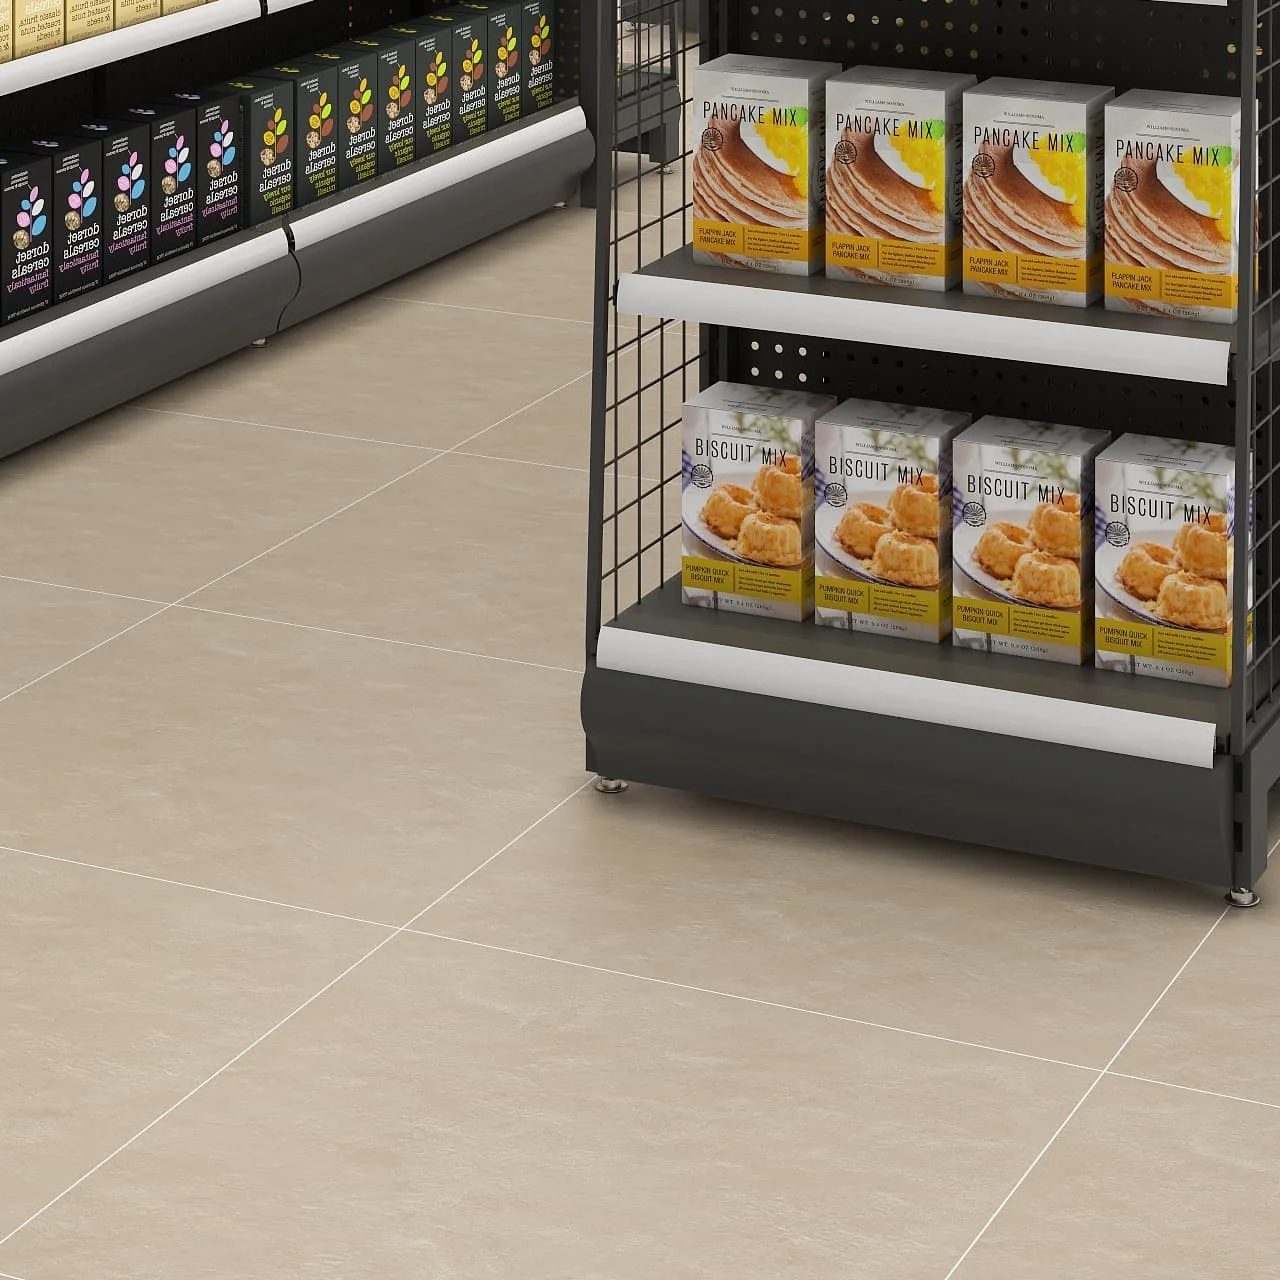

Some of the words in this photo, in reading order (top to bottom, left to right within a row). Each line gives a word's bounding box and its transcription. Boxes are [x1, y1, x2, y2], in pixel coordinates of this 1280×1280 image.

[703, 101, 765, 124] PANCAKE
[773, 108, 796, 126] MIX
[837, 113, 900, 137] PANCAKE
[908, 120, 933, 139] MIX
[974, 126, 1039, 150] PANCAKE
[1048, 134, 1074, 153] MIX
[1116, 139, 1183, 164] PANCAKE
[1193, 147, 1219, 167] MIX
[1112, 272, 1136, 282] FLAPPIN
[1137, 274, 1152, 283] JACK
[1112, 281, 1139, 290] PANCAKE
[1140, 283, 1152, 292] MIX
[696, 438, 753, 463] BISCUIT
[762, 447, 787, 468] MIX
[829, 456, 889, 481] BISCUIT
[898, 465, 923, 486] MIX
[967, 475, 1028, 500] BISCUIT
[1038, 484, 1065, 505] MIX
[1111, 494, 1174, 520] BISCUIT
[1184, 504, 1211, 525] MIX
[1099, 626, 1127, 637] PUMPKIN
[1129, 630, 1147, 640] QUICK
[1130, 640, 1142, 648] MIX
